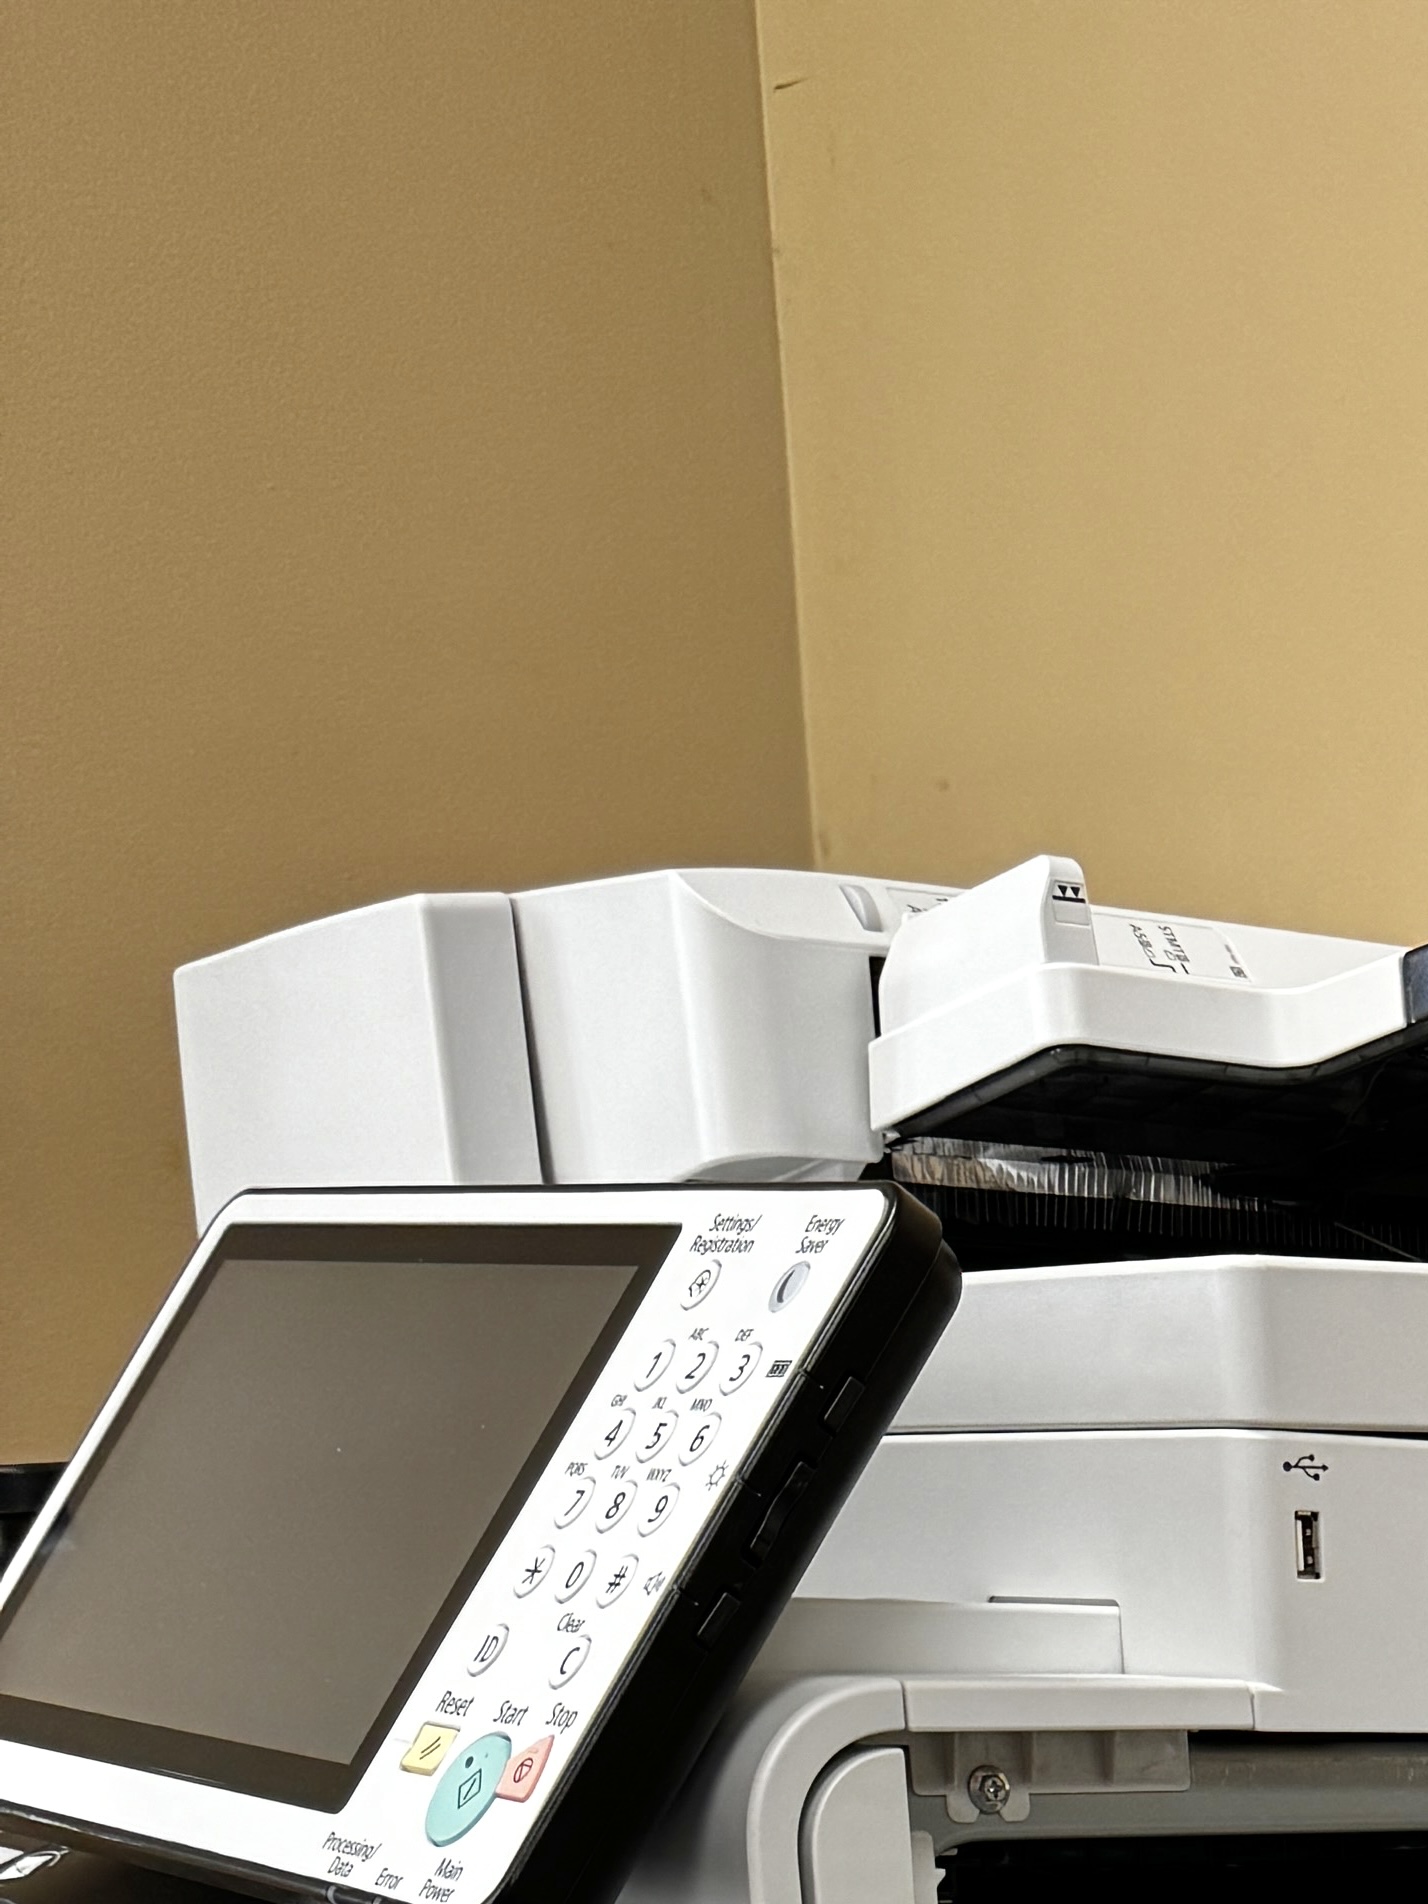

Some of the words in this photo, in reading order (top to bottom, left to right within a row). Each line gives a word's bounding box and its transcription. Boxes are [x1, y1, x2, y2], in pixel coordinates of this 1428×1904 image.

[709, 1213, 763, 1235] Settings/
[804, 1214, 846, 1236] Energy
[688, 1234, 755, 1256] Registration
[795, 1236, 829, 1254] Saver
[645, 1351, 663, 1379] 1
[684, 1352, 707, 1380] 2
[728, 1353, 751, 1382] 3
[604, 1419, 624, 1448] 4
[645, 1422, 668, 1450] 5
[688, 1424, 711, 1453] 6
[564, 1489, 586, 1517] 7
[605, 1491, 627, 1520] 8
[647, 1494, 669, 1524] 9
[565, 1561, 585, 1589] 0
[605, 1565, 629, 1594] #
[556, 1612, 586, 1634] Clear
[473, 1634, 500, 1663] ID
[559, 1646, 581, 1676] C
[434, 1690, 475, 1717] Reset
[492, 1700, 529, 1727] Start
[545, 1702, 579, 1735] Stop
[322, 1831, 383, 1863] Processing/
[327, 1856, 354, 1878] Data
[374, 1867, 404, 1890] Error
[433, 1857, 464, 1882] Main
[418, 1878, 456, 1903] Power
